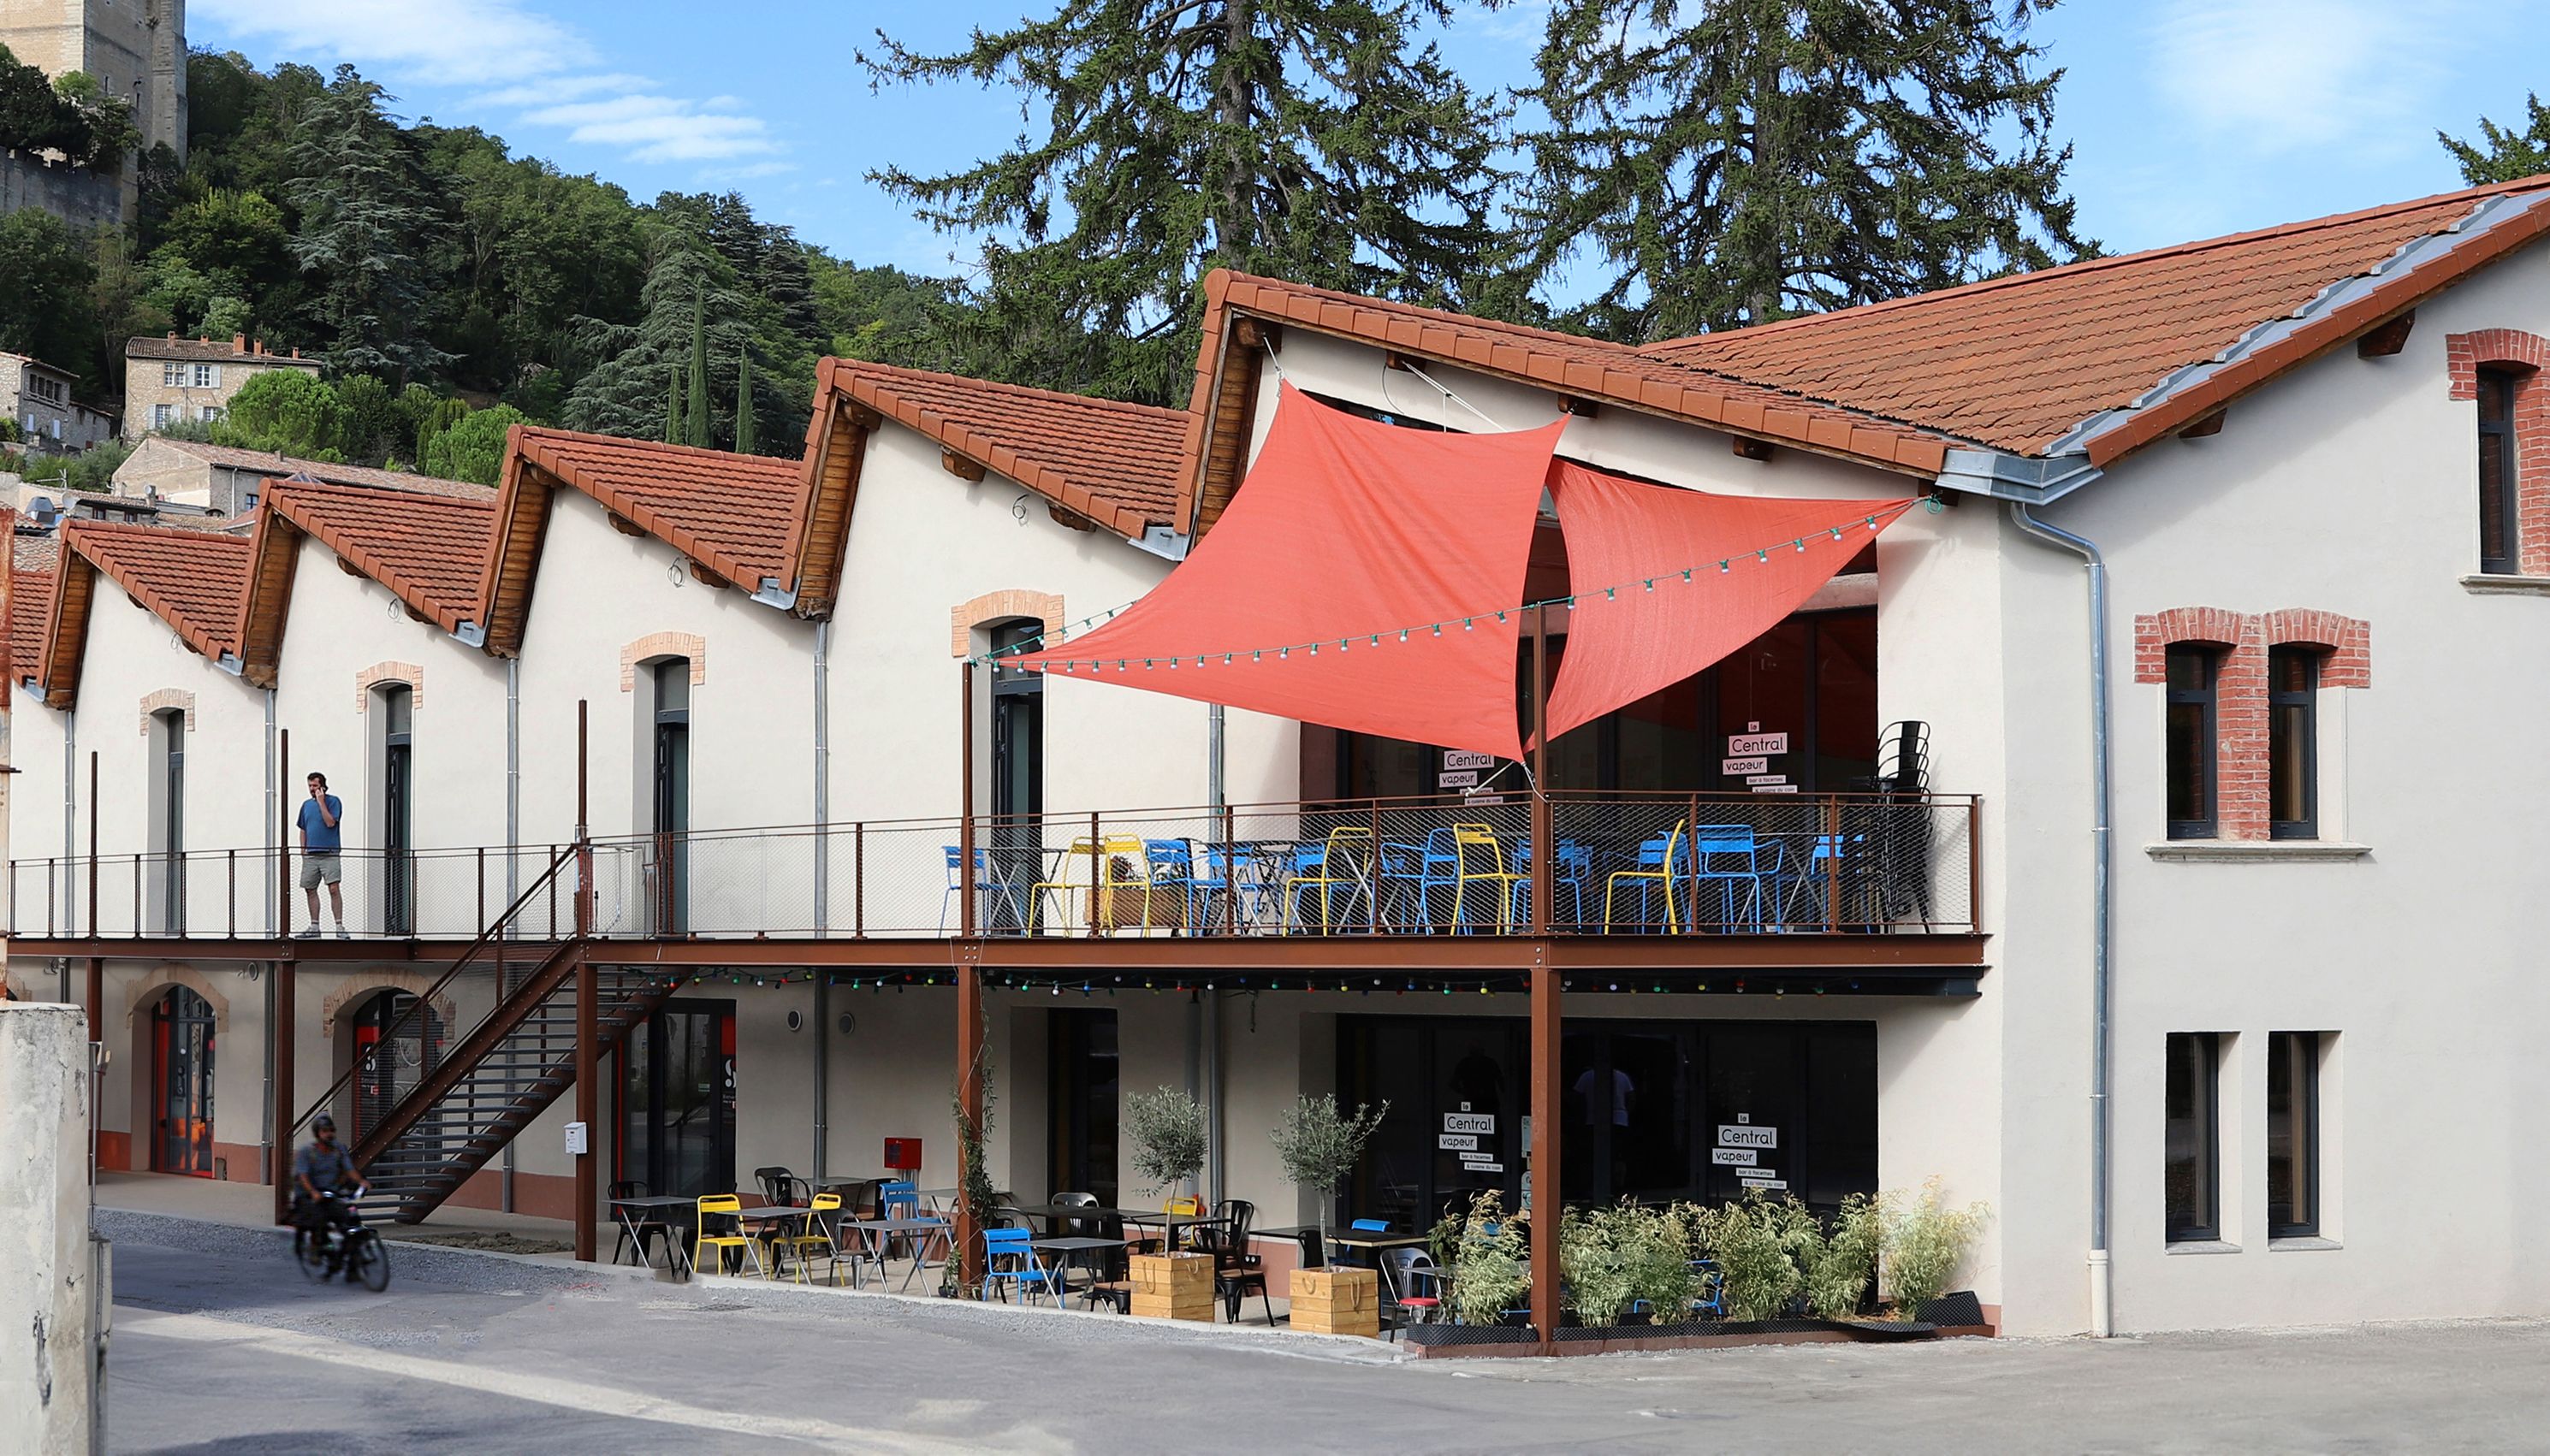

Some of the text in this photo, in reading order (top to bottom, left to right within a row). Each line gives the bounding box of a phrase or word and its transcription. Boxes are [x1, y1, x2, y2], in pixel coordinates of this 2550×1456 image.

[1732, 737, 1783, 753] Central
[1447, 753, 1491, 766] Central
[1726, 761, 1764, 772] vapeur
[1442, 775, 1474, 785] vapeur
[1447, 1116, 1491, 1131] Central
[1722, 1128, 1773, 1145] Central
[1442, 1138, 1474, 1148] vapeur
[1716, 1152, 1753, 1163] vapeur
